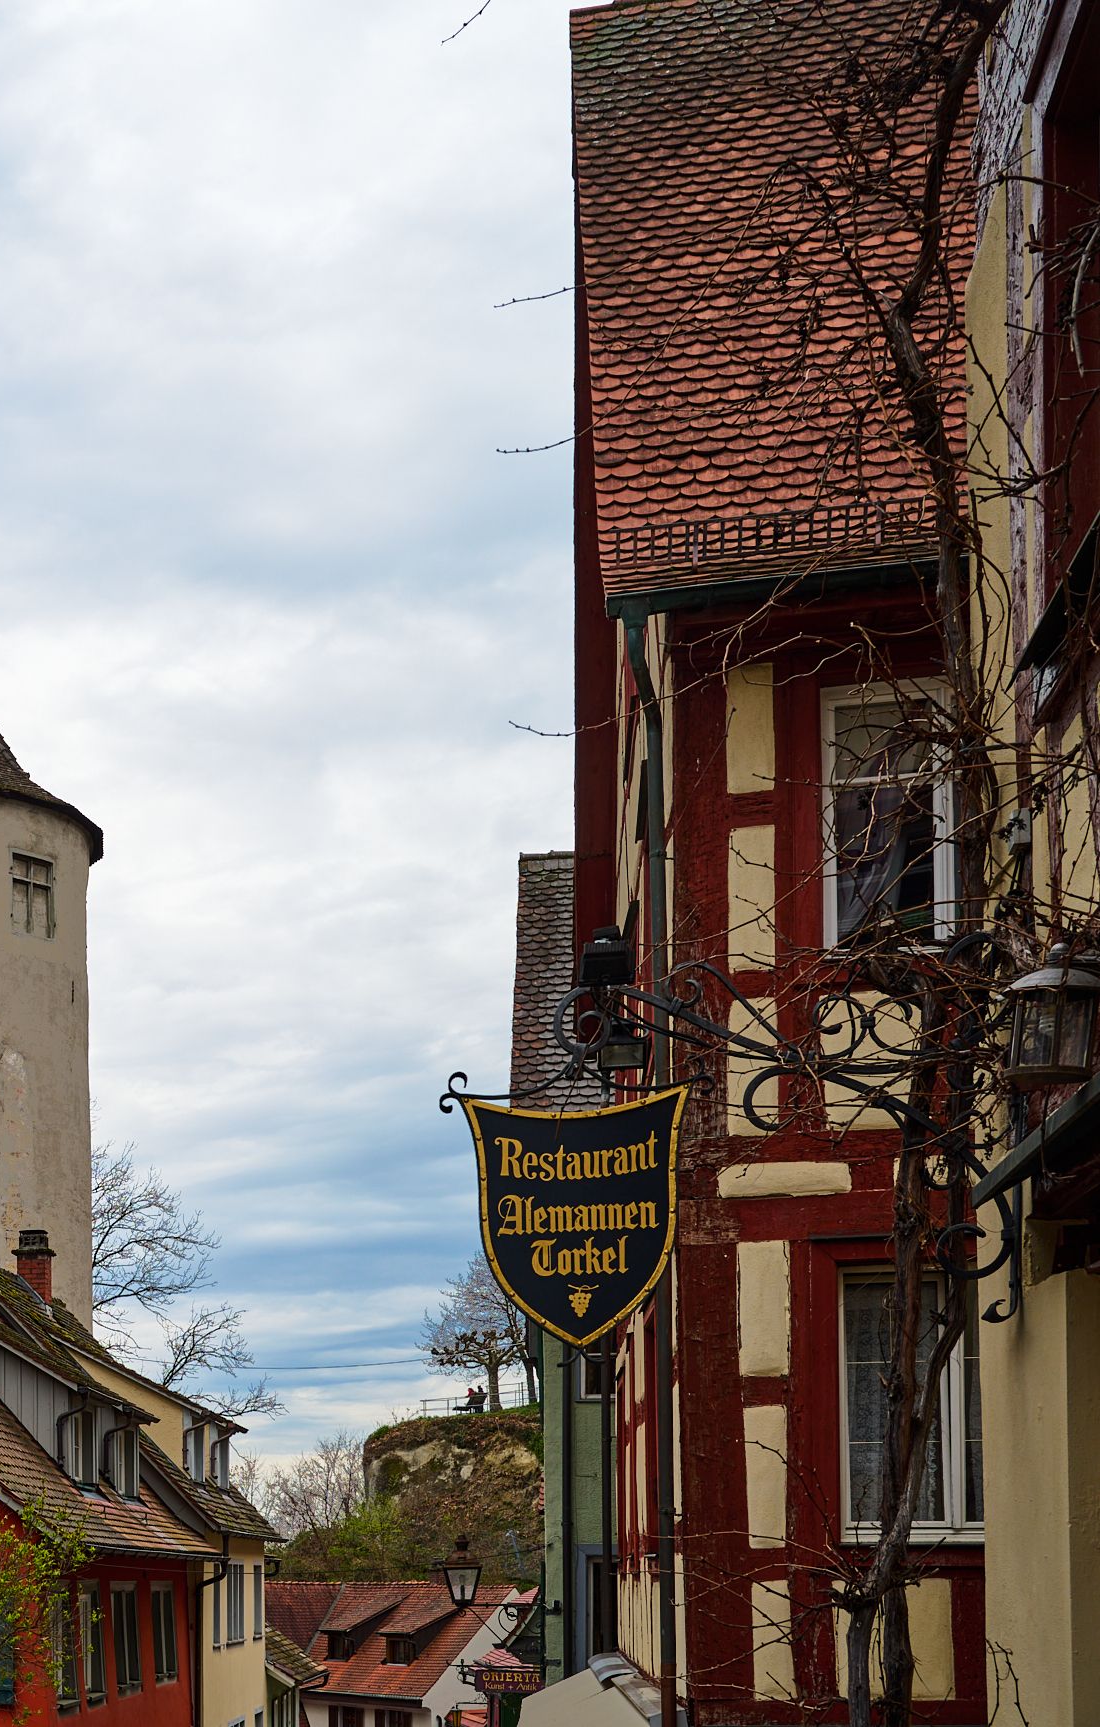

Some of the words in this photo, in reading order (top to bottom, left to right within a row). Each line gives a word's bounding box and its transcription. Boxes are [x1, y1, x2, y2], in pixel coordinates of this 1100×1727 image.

[494, 1130, 658, 1181] Restaurant
[497, 1194, 659, 1237] Alemannen
[530, 1235, 629, 1277] Torkel
[485, 1682, 504, 1690] Kunst
[515, 1683, 537, 1691] Antik
